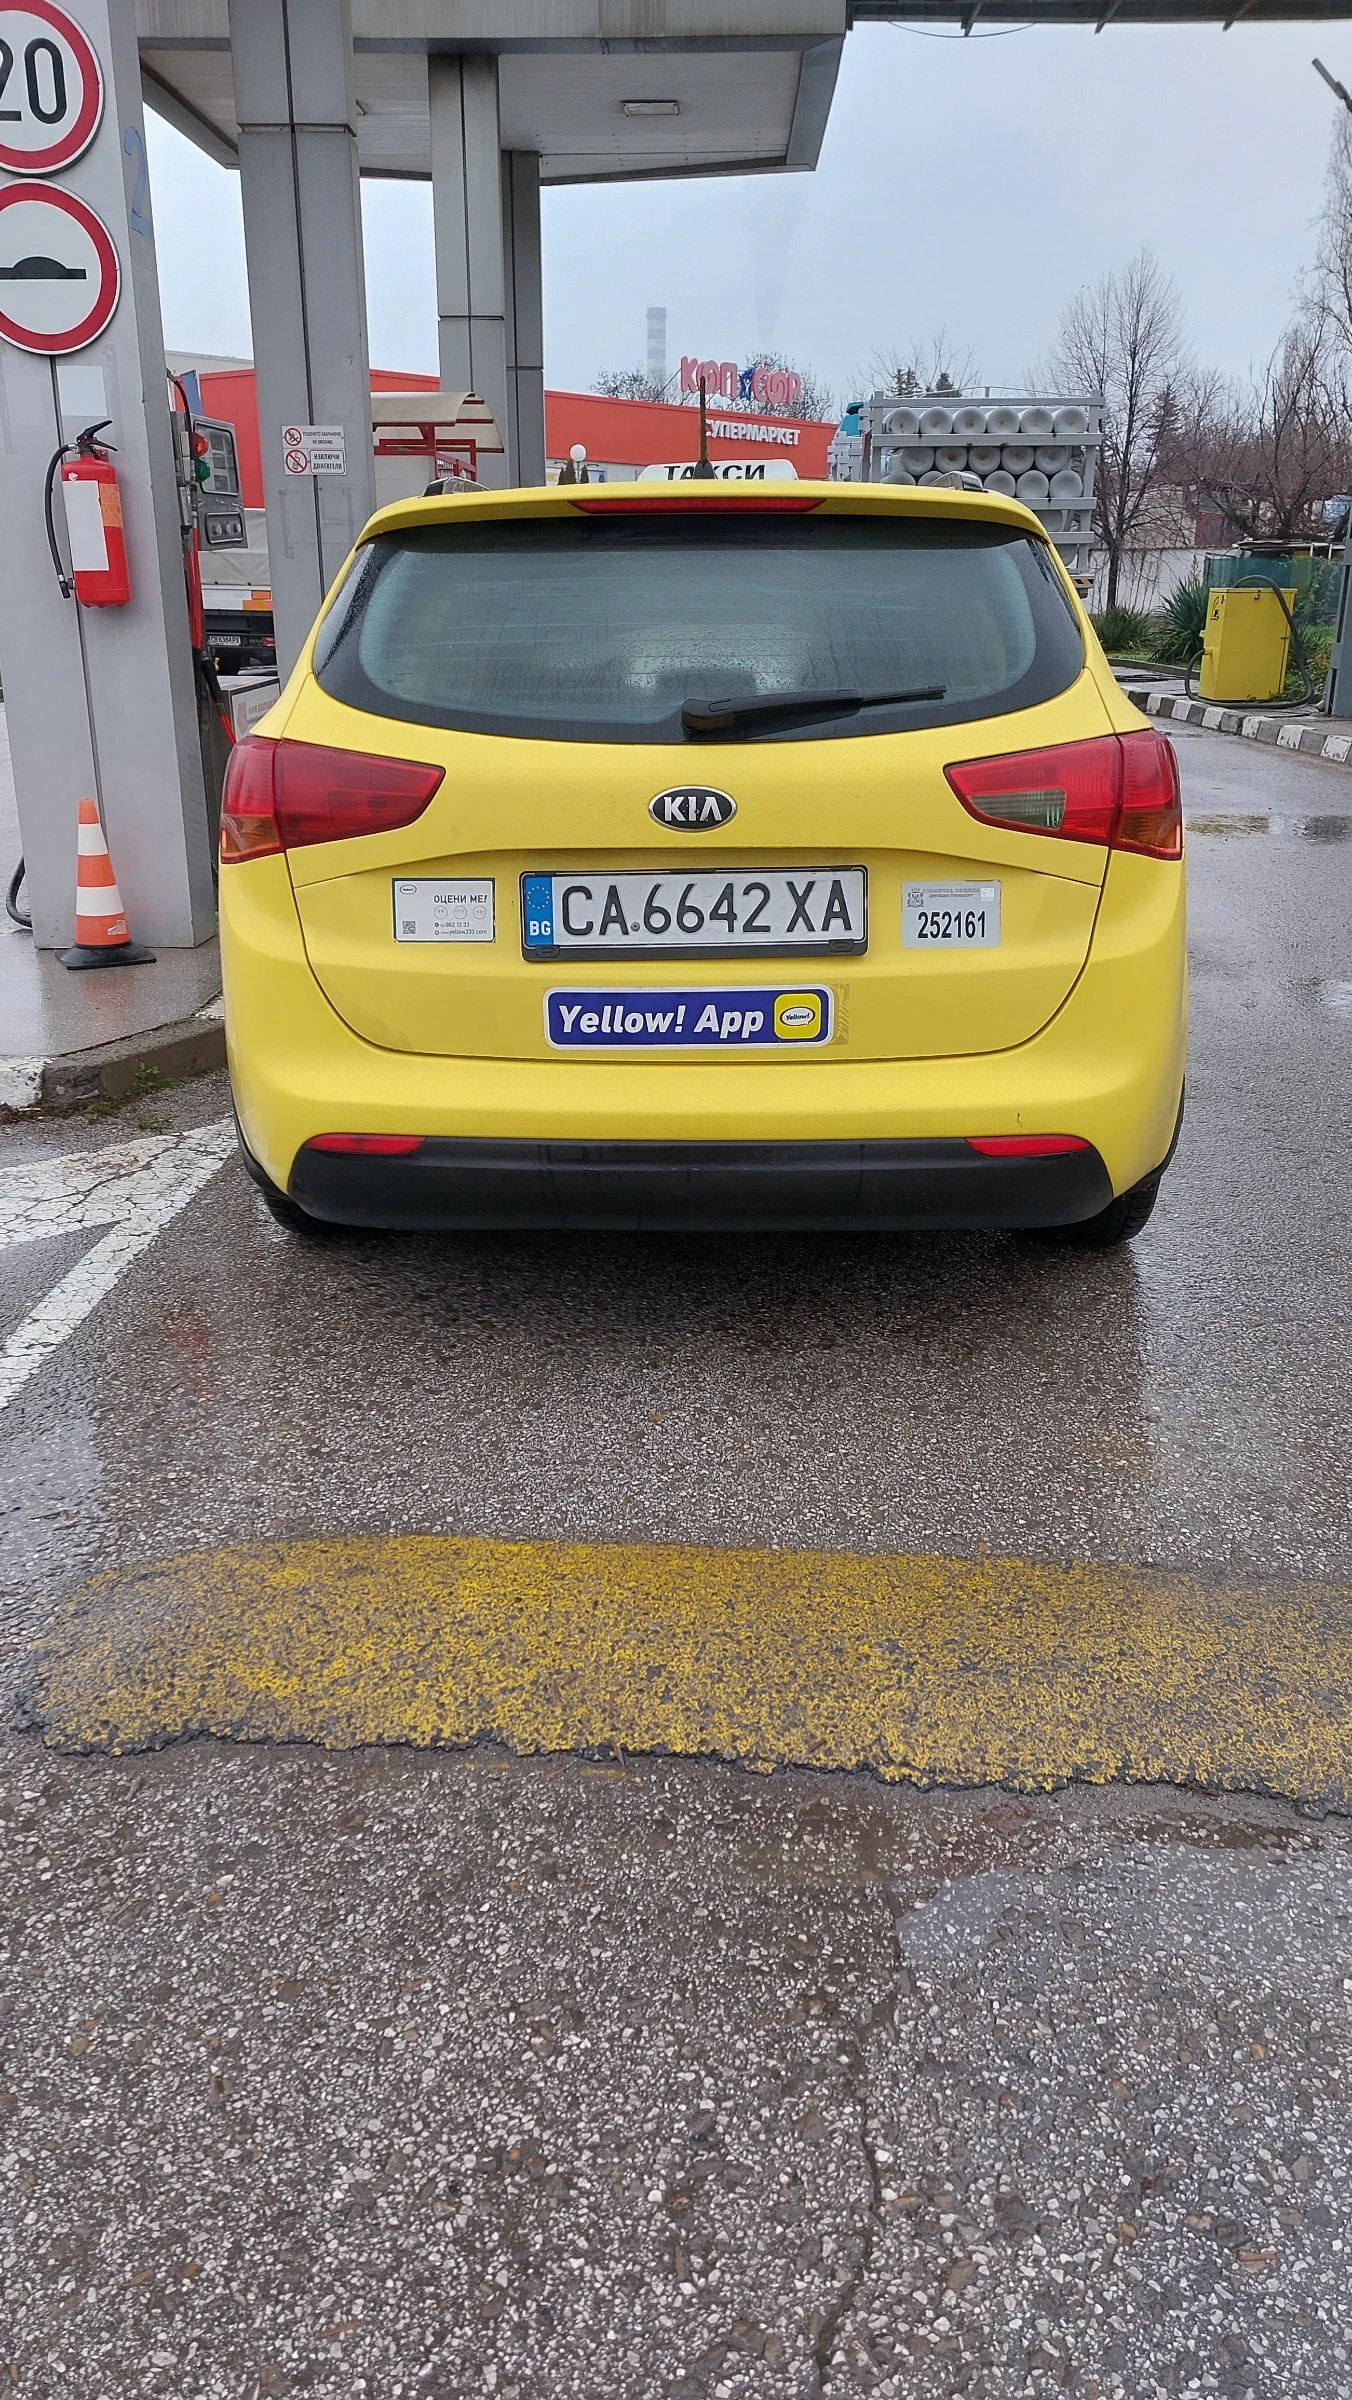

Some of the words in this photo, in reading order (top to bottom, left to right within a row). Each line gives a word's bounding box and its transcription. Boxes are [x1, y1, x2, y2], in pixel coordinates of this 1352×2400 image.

[312, 462, 342, 470] ДВИГАТЕЛЯ
[663, 796, 723, 822] KIA
[433, 894, 467, 905] ОЦЕНИ
[470, 894, 488, 904] МЕ!
[643, 881, 771, 934] 6642
[529, 920, 551, 936] BG
[917, 910, 986, 939] 252161
[558, 1004, 687, 1034] Yellow!
[693, 1004, 764, 1039] App
